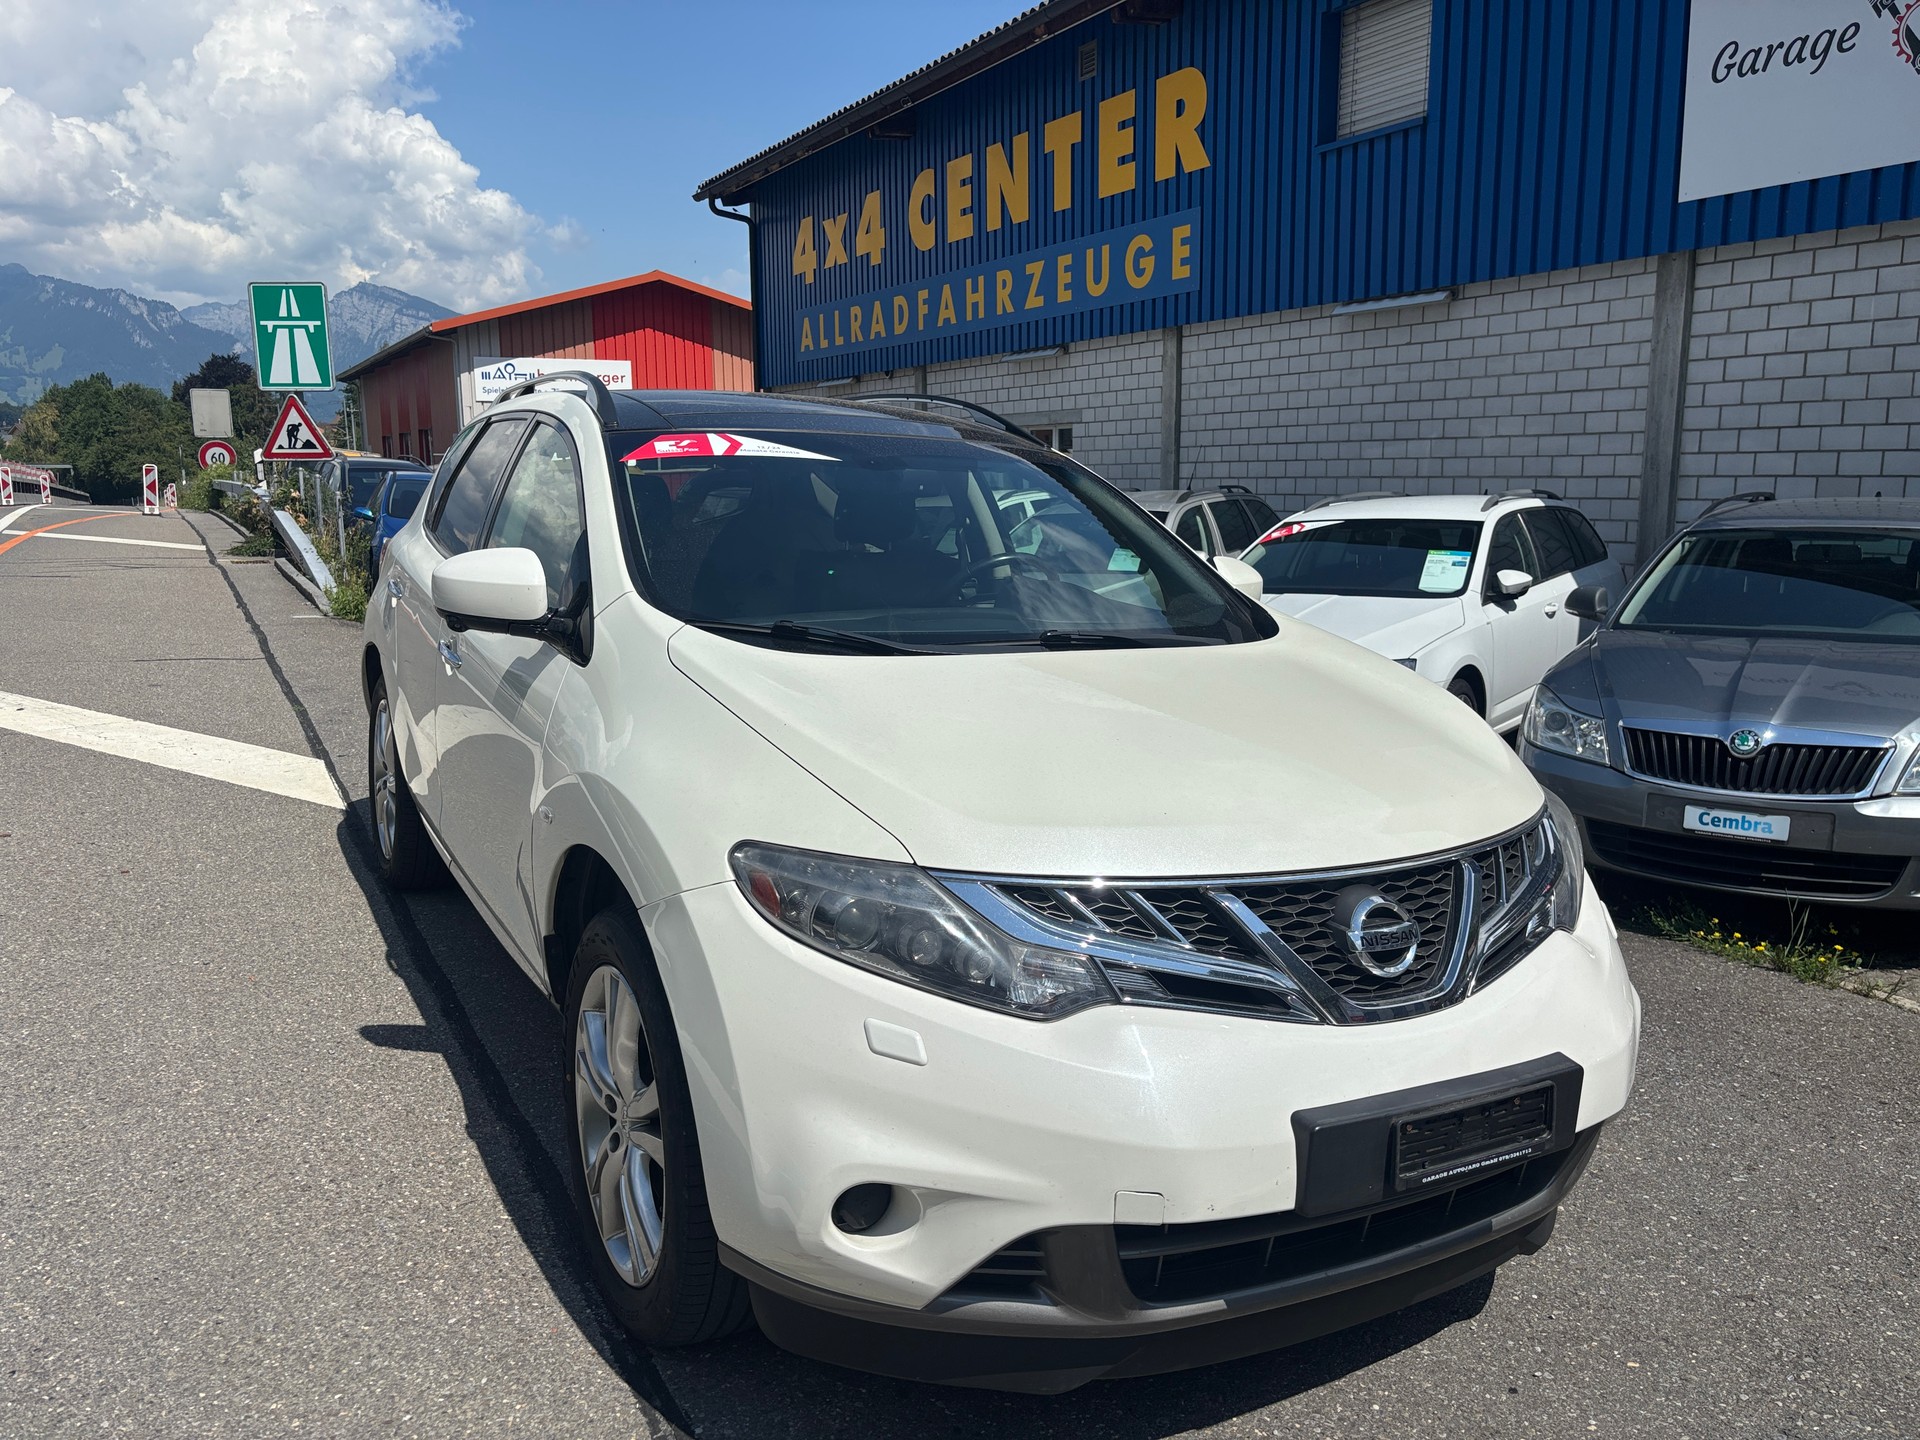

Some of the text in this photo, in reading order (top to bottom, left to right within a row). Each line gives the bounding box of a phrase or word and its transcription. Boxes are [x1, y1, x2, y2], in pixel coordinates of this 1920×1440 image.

[1711, 22, 1860, 84] Garage
[793, 67, 1211, 285] 4x4 CENTER
[801, 224, 1192, 352] ALLRADFAHRZEUGE
[210, 452, 226, 464] 60
[1698, 811, 1773, 834] Cembra
[1360, 930, 1418, 947] NISSAN
[1422, 1171, 1448, 1183] GARAGE
